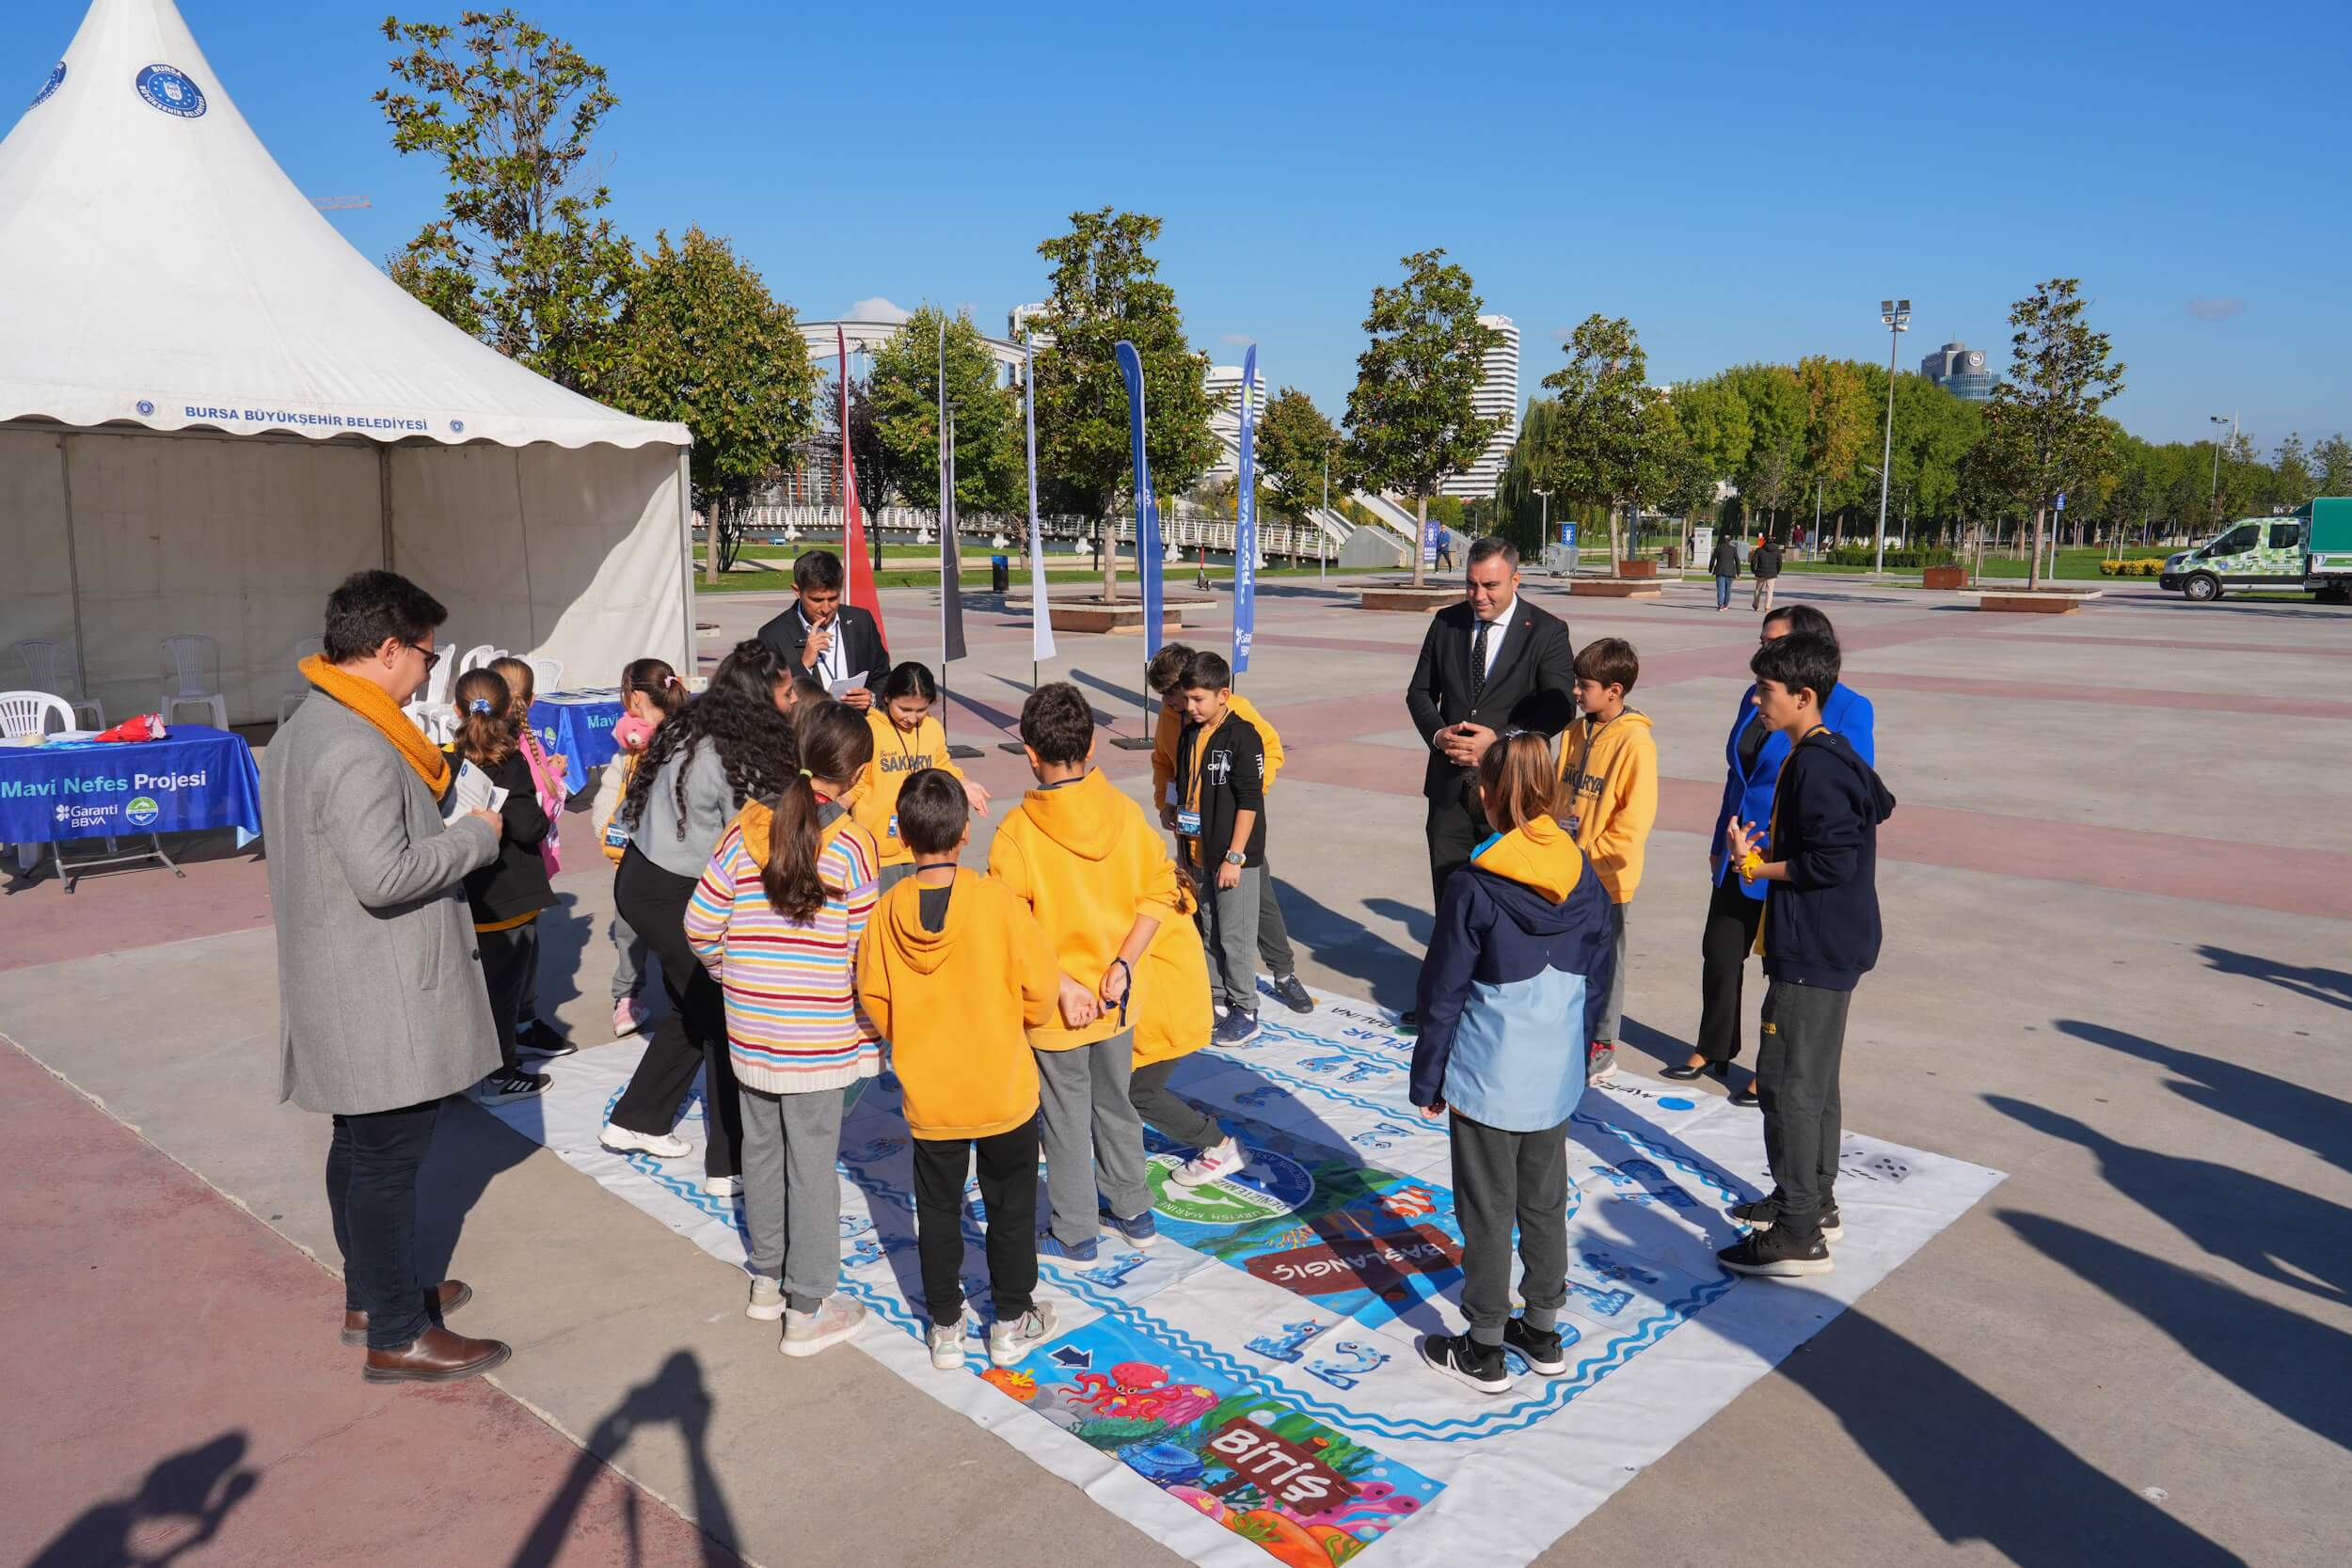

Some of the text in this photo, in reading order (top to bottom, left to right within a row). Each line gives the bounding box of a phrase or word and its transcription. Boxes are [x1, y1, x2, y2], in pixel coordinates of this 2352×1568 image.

[151, 65, 183, 79] BURSA
[184, 405, 428, 431] BURSA BÜYÜKŞEHİR BELEDİYESİ
[1, 770, 207, 799] Mavi Nefes Projesi
[71, 804, 119, 817] Garanti
[72, 817, 106, 829] BBVA
[1211, 1428, 1332, 1502] BİTİŞ
